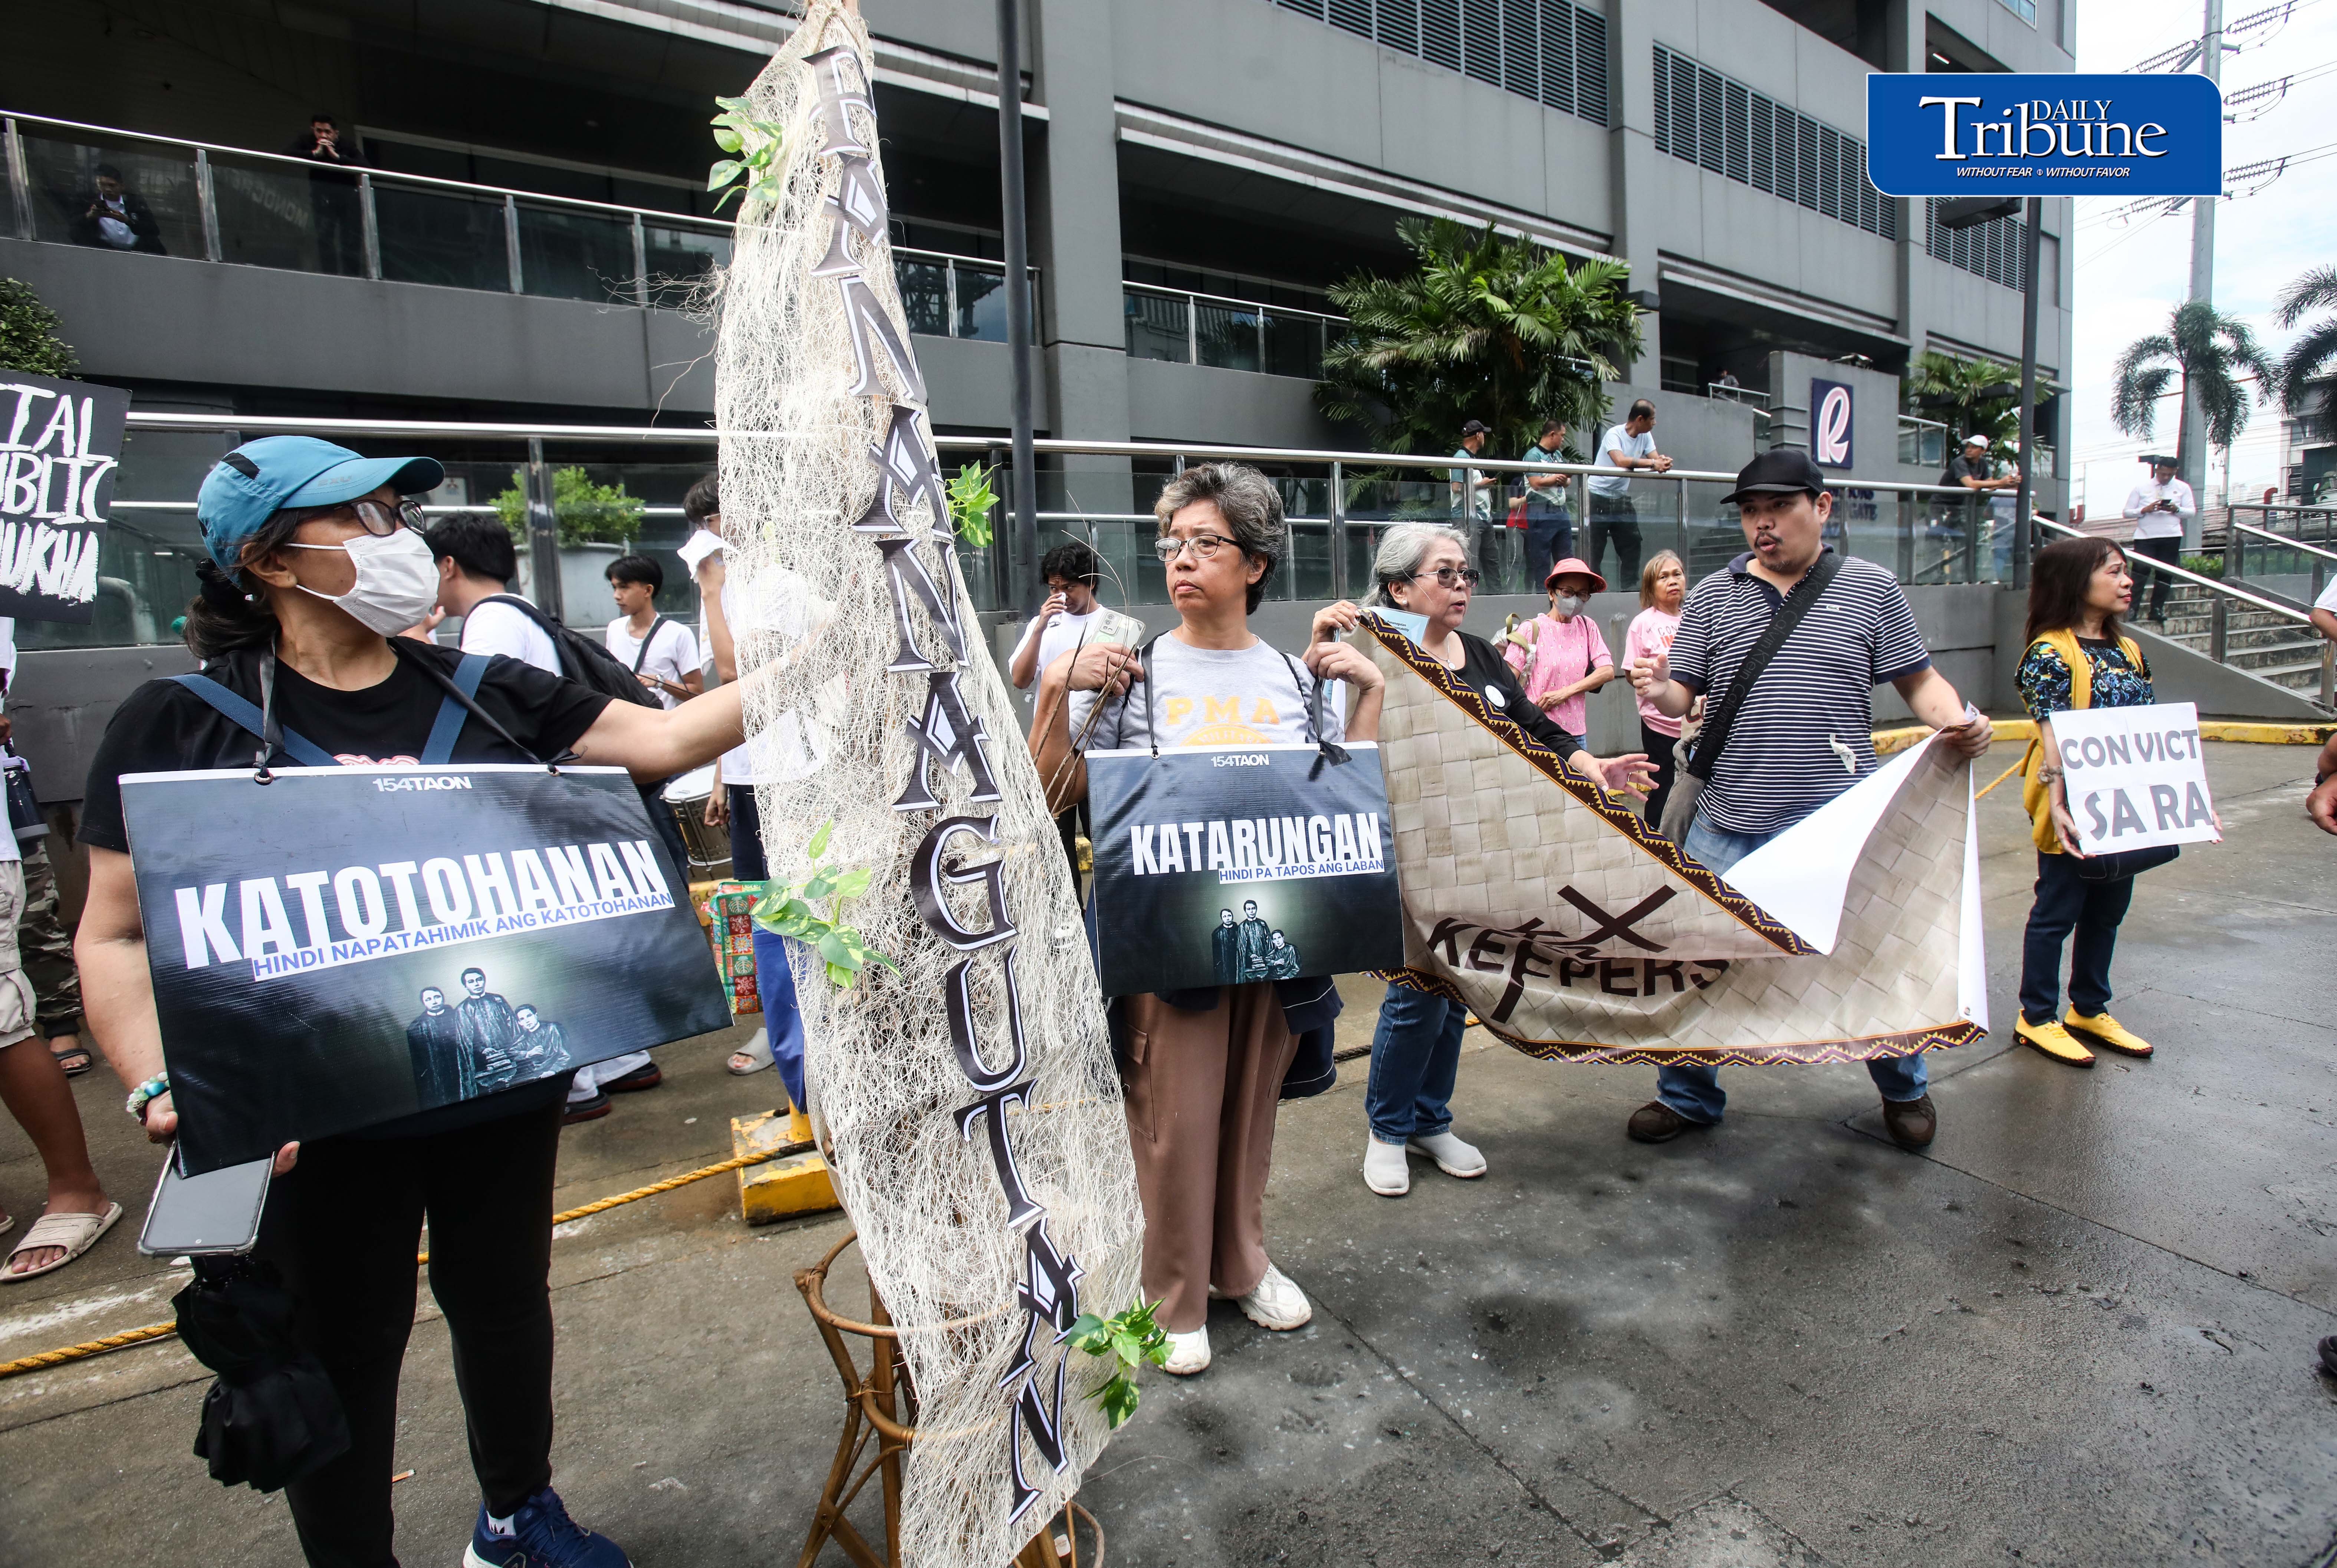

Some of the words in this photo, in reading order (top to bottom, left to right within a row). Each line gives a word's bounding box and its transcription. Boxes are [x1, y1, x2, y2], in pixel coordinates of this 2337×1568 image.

[1818, 386, 1850, 463] R
[0, 452, 118, 524] BLIC
[0, 521, 99, 604] UKHA
[1761, 611, 1797, 648] Calvin
[1740, 649, 1769, 679] Klein
[1166, 696, 1280, 725] PMA
[1718, 684, 1745, 722] Calvin
[1211, 754, 1269, 767] 154TAON
[2061, 729, 2198, 769] CONVICT
[373, 776, 472, 792] 154TAON
[802, 45, 1085, 1525] PANANAGUTAN
[2085, 782, 2212, 841] SARA
[1131, 812, 1383, 875] KATARUNGAN
[1220, 870, 1252, 881] HINDI
[1256, 867, 1272, 879] PA
[1277, 864, 1315, 877] TAPOS
[1318, 862, 1342, 874] ANG
[1345, 860, 1383, 872] LABAN
[175, 840, 669, 970] KATOTOHANAN
[254, 950, 324, 977] HINDI
[333, 917, 491, 961] NAPATAHIMIK
[496, 913, 537, 932] ANG
[543, 893, 673, 924] KATOTOHANAN
